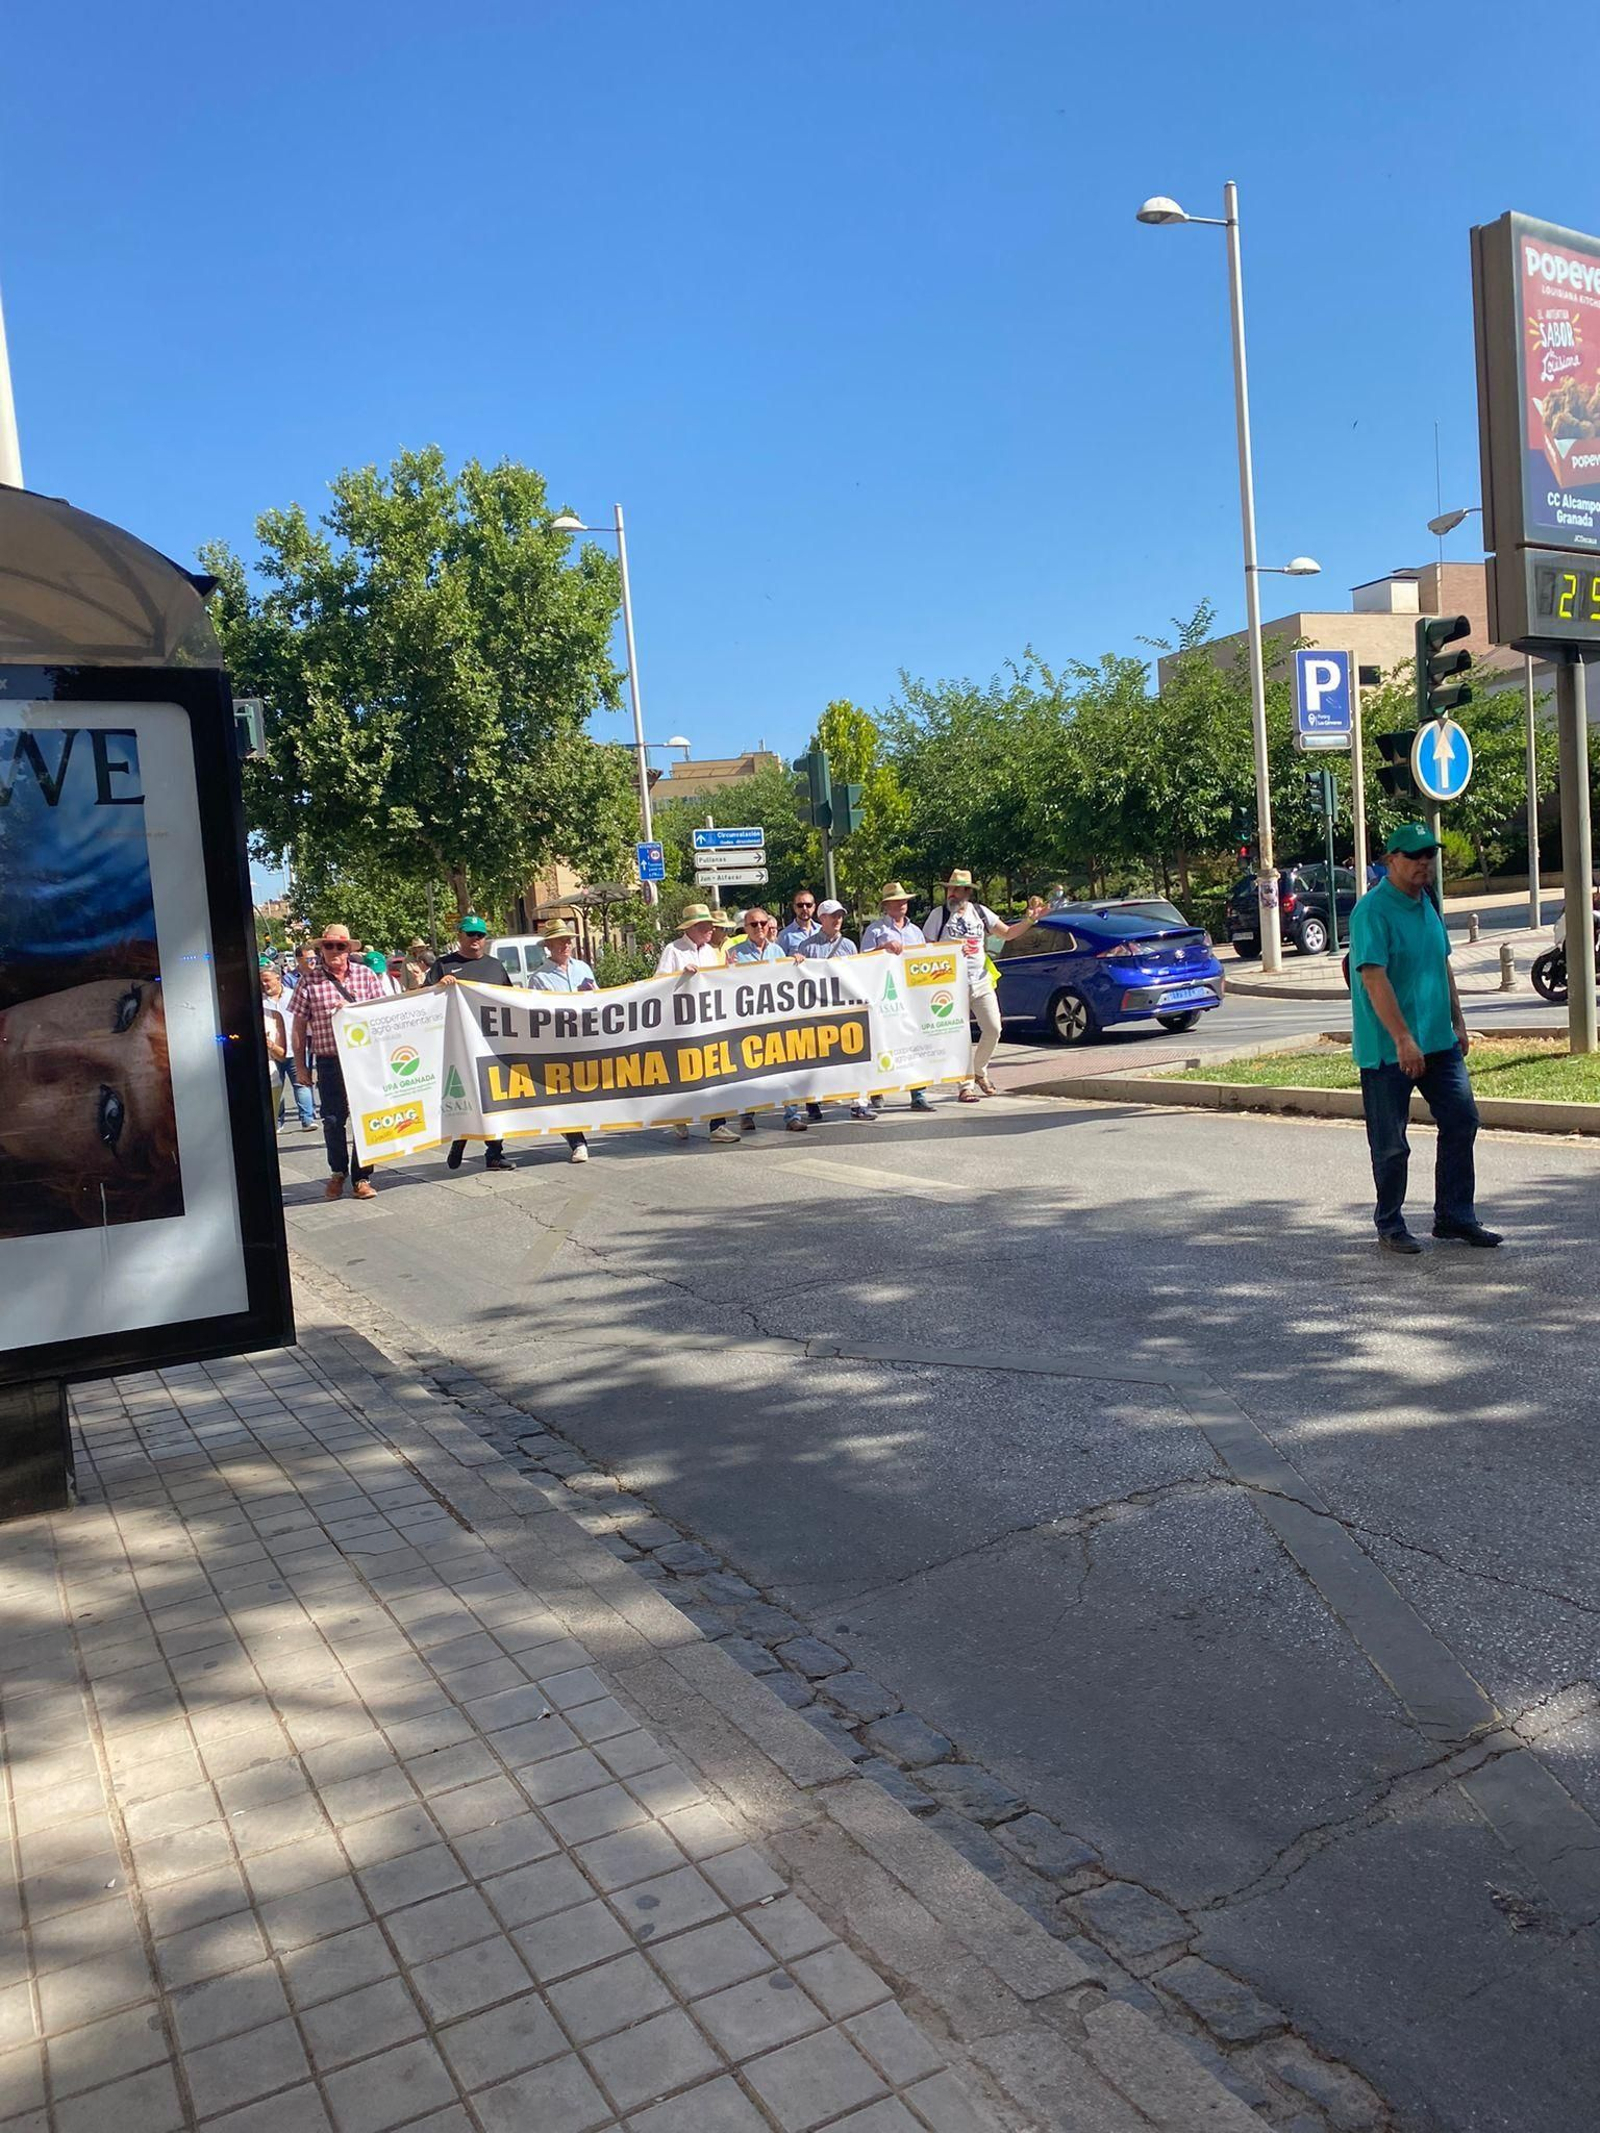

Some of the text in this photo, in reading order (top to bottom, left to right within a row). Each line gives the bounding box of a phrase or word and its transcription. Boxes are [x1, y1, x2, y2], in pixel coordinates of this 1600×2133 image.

[1539, 322, 1575, 348] SABOR
[1547, 491, 1561, 506] CC
[1556, 509, 1594, 527] Granada
[1304, 660, 1341, 711] P
[909, 960, 951, 974] COAG
[370, 1008, 426, 1027] cooperativas
[371, 1013, 443, 1036] agro-alimentarias
[480, 1005, 518, 1038] EL
[529, 996, 662, 1038] PRECIO
[673, 988, 727, 1027] DEL
[489, 1063, 536, 1101] LA
[544, 1051, 670, 1096] RUINA
[677, 1040, 737, 1083] DEL
[741, 1021, 864, 1069] CAMPO
[383, 1082, 399, 1093] UPA
[400, 1073, 436, 1089] GRANADA
[368, 1108, 418, 1132] COAG
